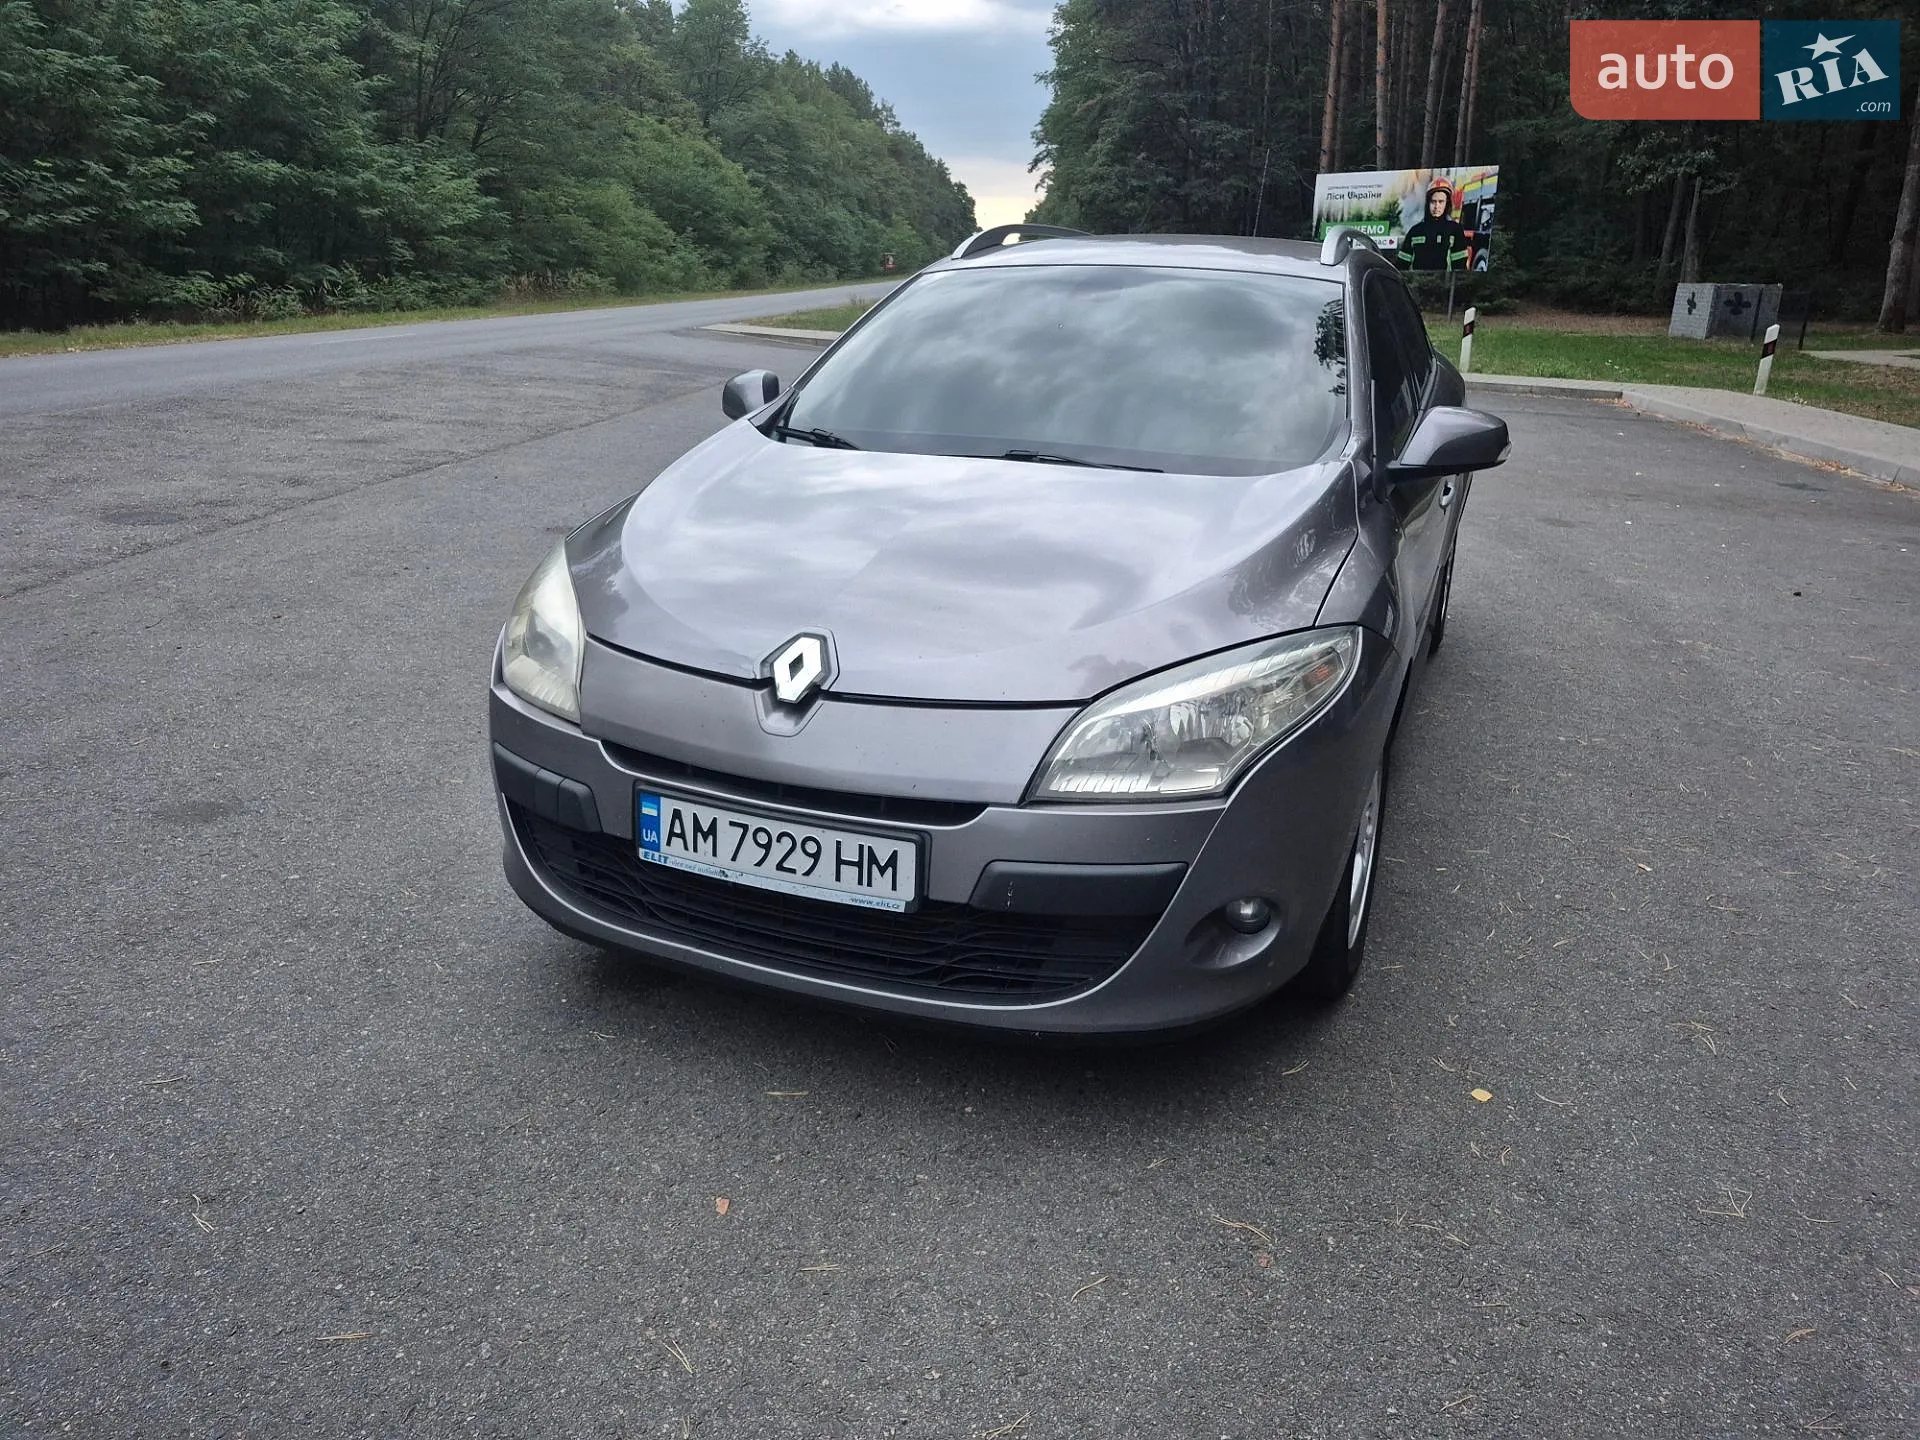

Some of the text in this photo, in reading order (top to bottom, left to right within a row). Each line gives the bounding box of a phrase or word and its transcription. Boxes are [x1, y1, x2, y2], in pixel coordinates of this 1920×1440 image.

[642, 828, 659, 844] UA
[643, 851, 670, 865] ELIT
[665, 808, 899, 892] AM 7929 HM
